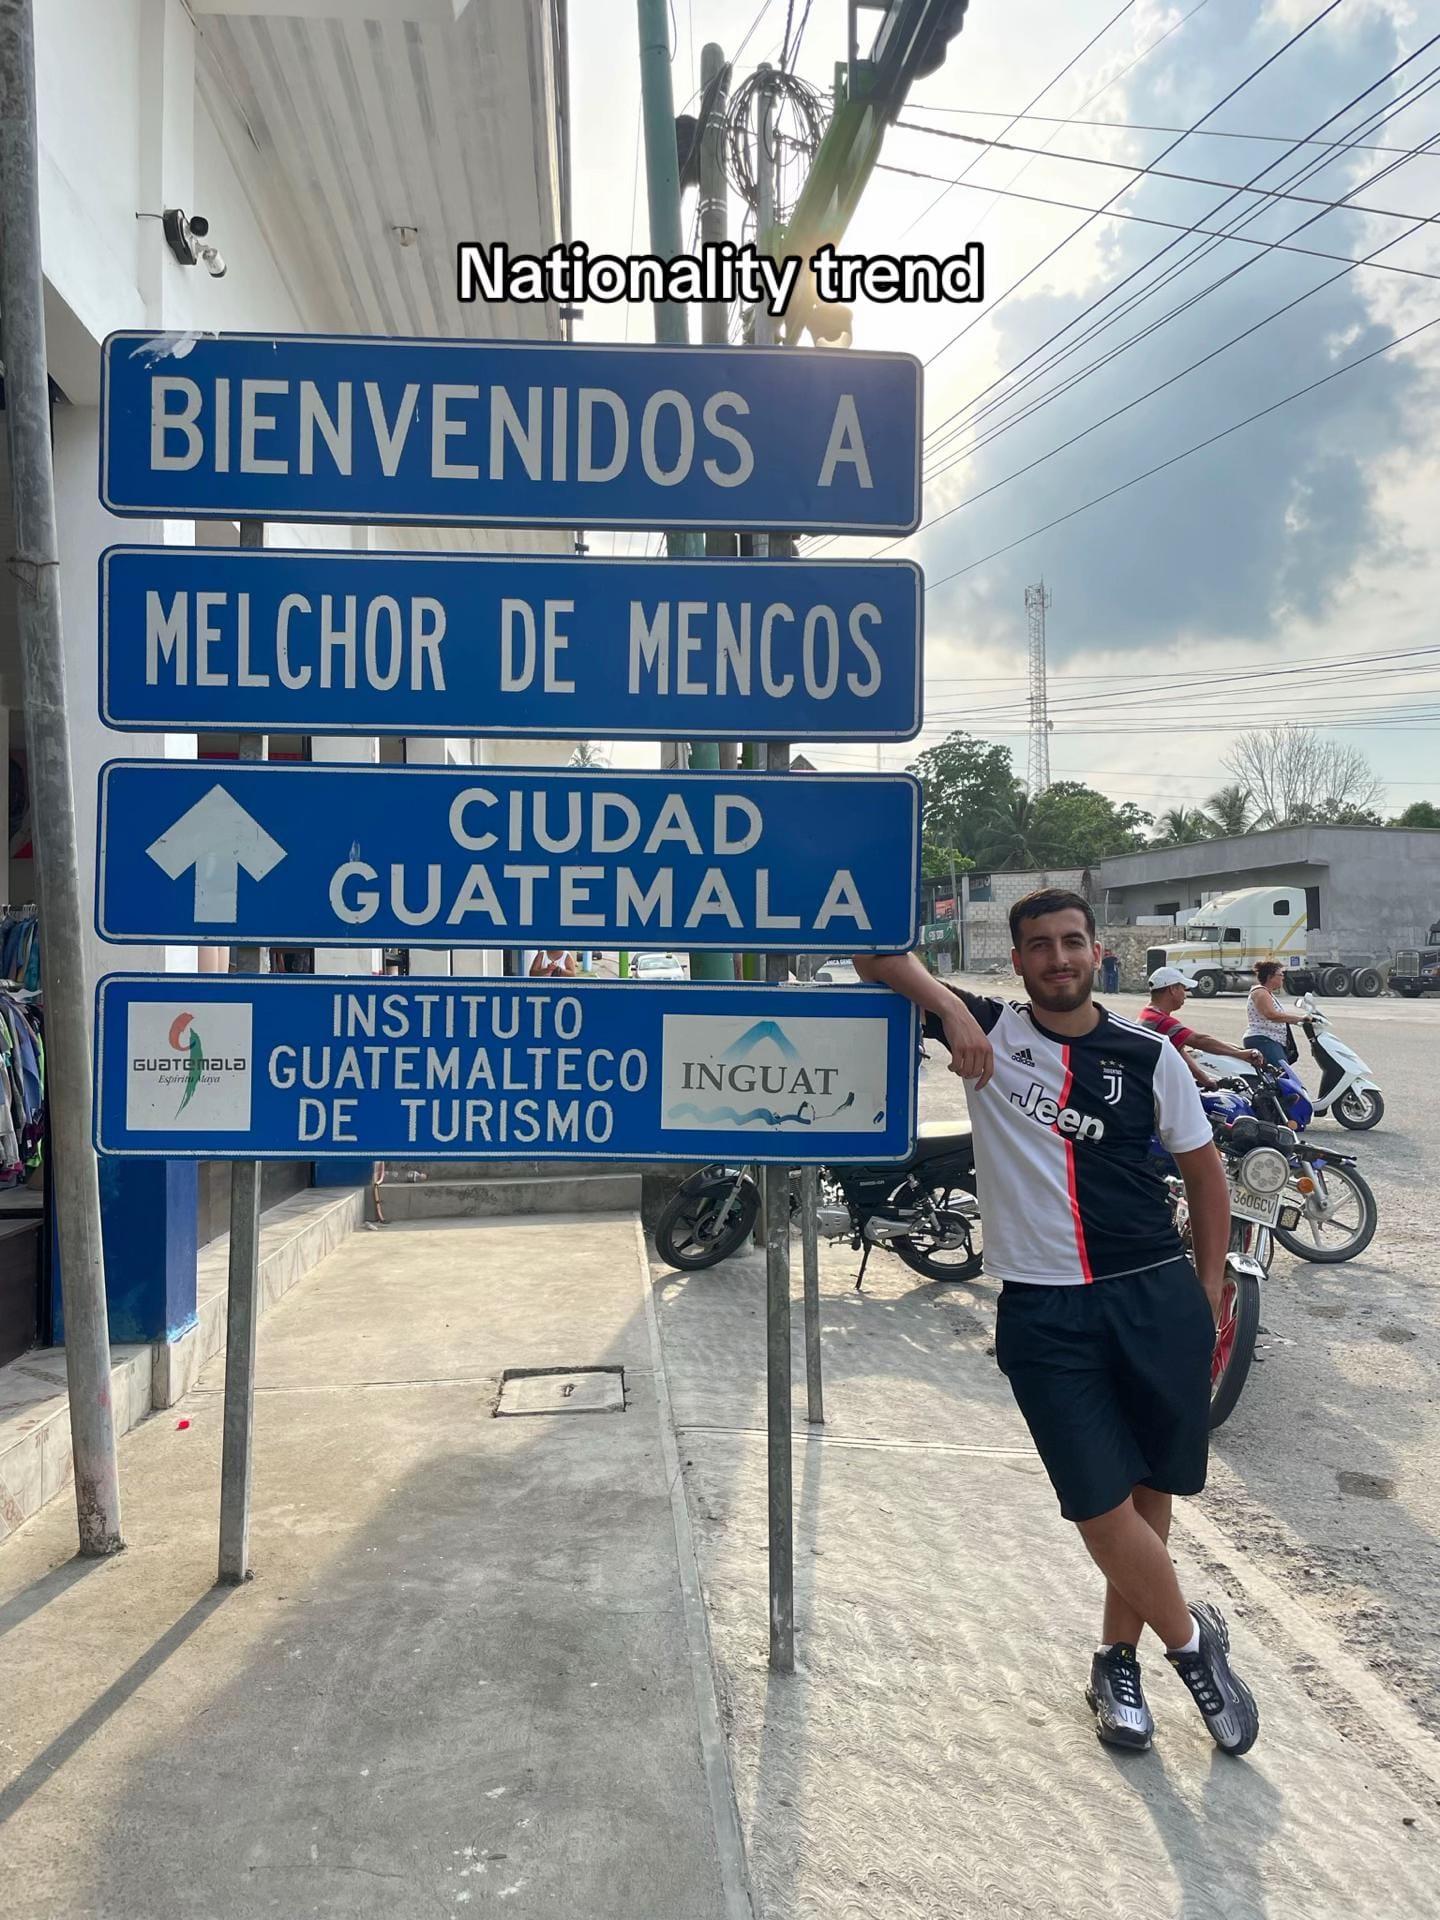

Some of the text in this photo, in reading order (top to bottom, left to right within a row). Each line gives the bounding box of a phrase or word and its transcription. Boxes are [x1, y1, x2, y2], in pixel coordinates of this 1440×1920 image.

[150, 375, 874, 489] BIENVENIDOS A
[145, 590, 883, 701] MELCHOR DE MENCOS
[449, 788, 763, 855] CIUDAD
[329, 862, 872, 930] GUATEMALA
[333, 994, 583, 1040] INSTITUTO
[268, 1046, 648, 1092] GUATEMALTECO
[680, 1062, 839, 1095] INGUAT
[1011, 1055, 1035, 1068] adidas
[298, 1098, 614, 1144] DE TURISMO
[1010, 1083, 1105, 1142] Jeep
